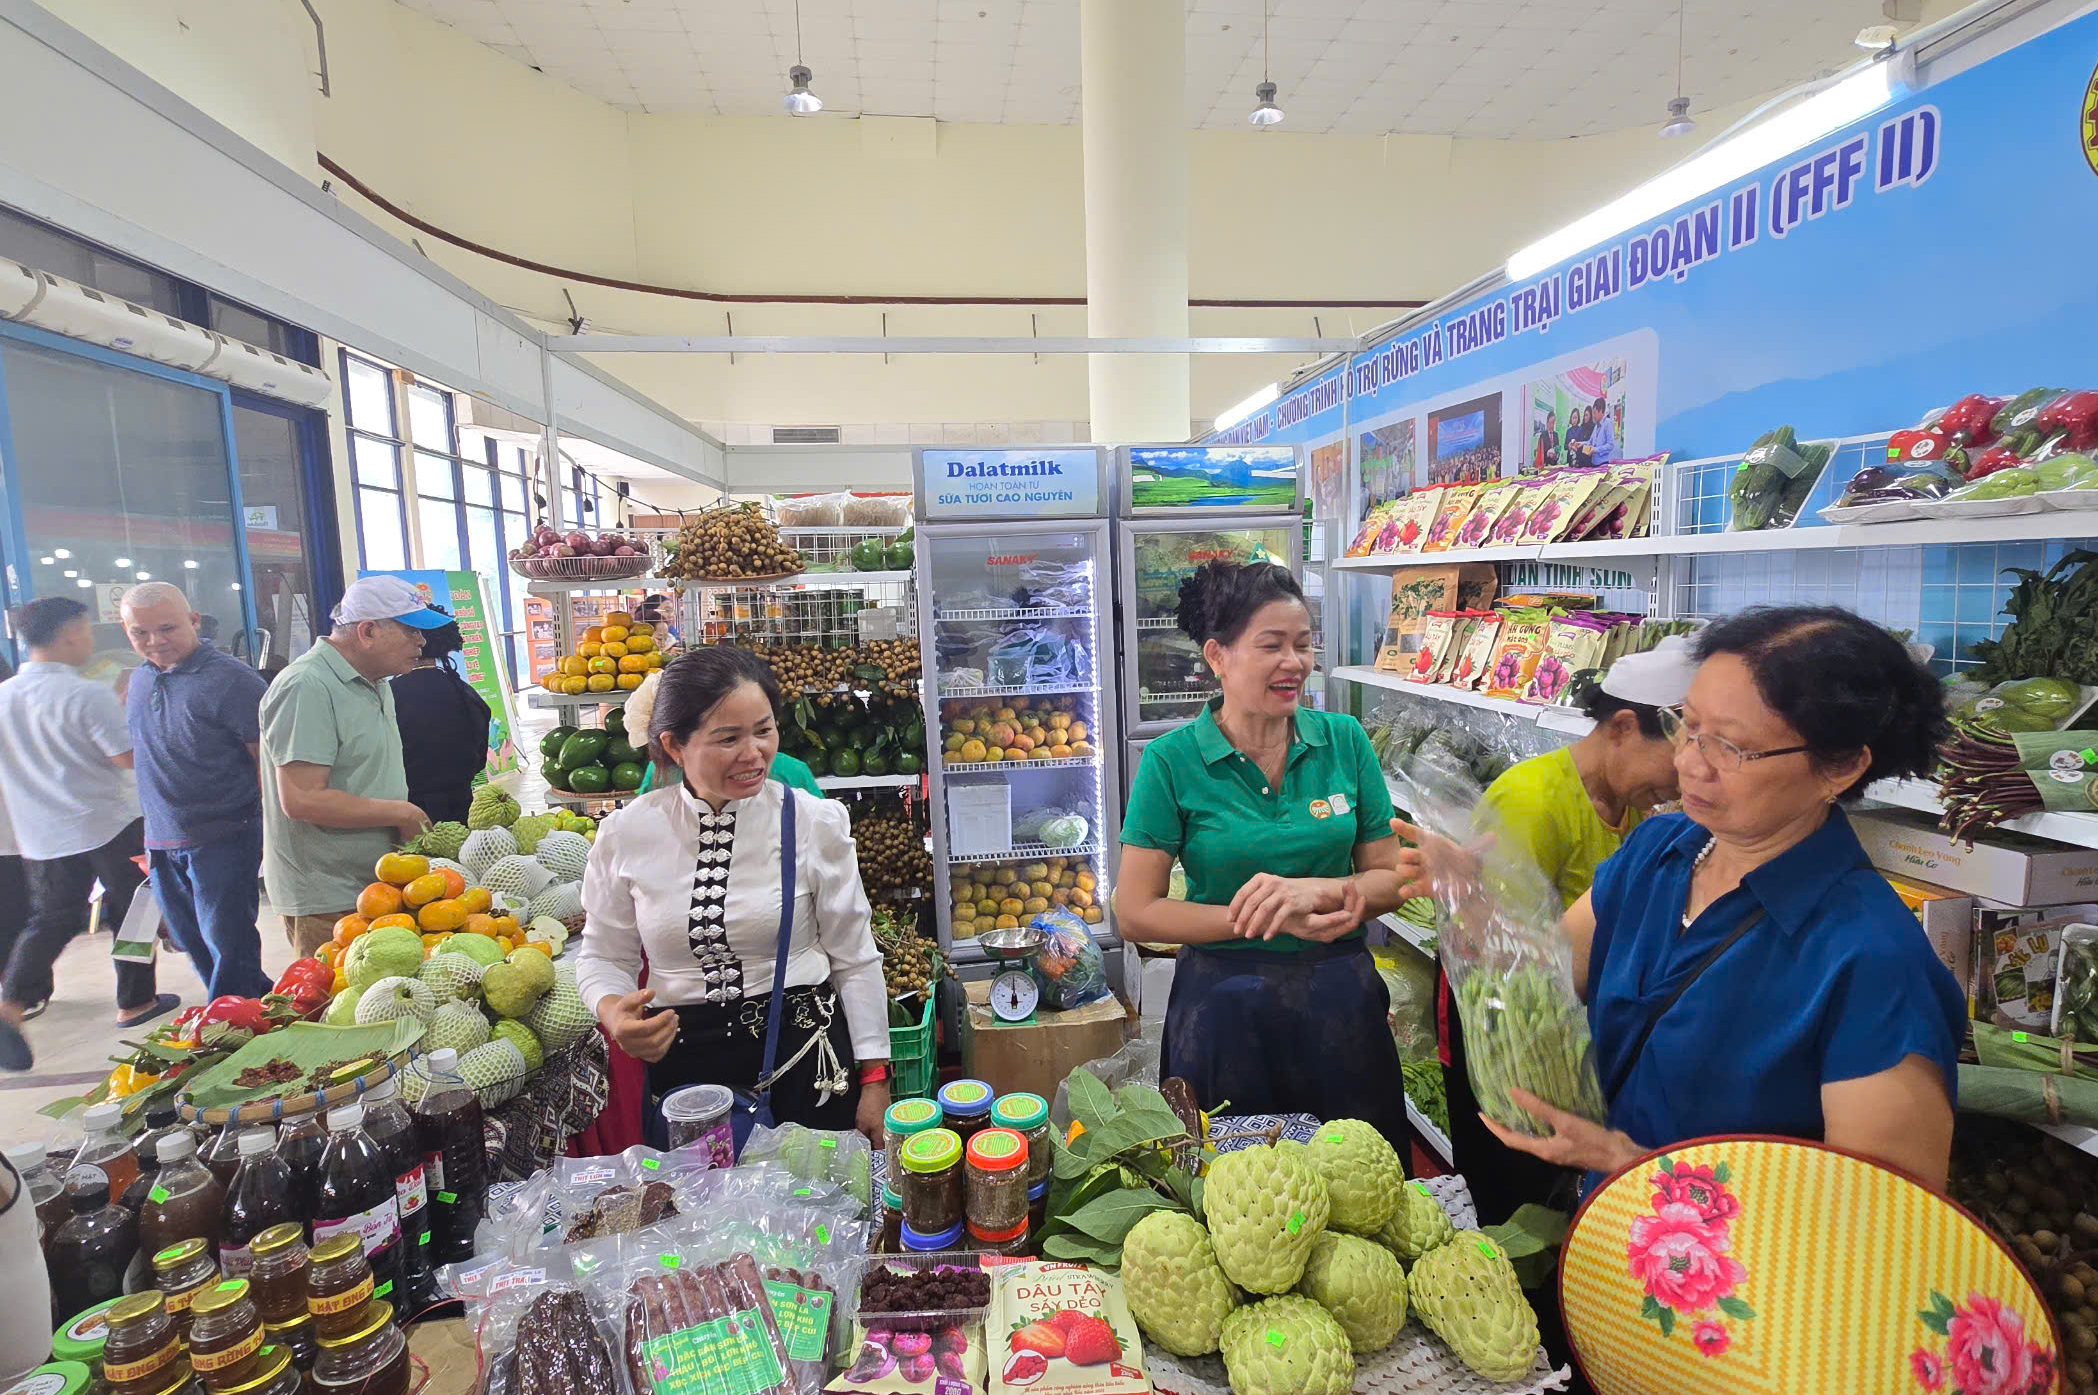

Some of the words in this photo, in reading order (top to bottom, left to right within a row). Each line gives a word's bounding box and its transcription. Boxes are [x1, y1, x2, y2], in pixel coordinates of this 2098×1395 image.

[1253, 413, 1269, 440] NAM
[1277, 390, 1309, 431] CHƯƠNG
[1309, 378, 1337, 415] TRÌNH
[1356, 353, 1379, 398] TRỢ
[1382, 340, 1419, 386] RỪNG
[1422, 323, 1443, 368] VÀ
[1447, 301, 1506, 358] TRANG
[1511, 271, 1562, 331] TRẠI
[1568, 248, 1621, 311] GIAI
[1628, 203, 1721, 280] ĐOẠN
[1730, 186, 1758, 248] II
[1771, 138, 1866, 235] (FFF
[1879, 110, 1936, 189] II)
[946, 460, 1063, 478] Dalatmilk
[938, 492, 962, 505] SỮA
[965, 493, 993, 504] TƯƠI
[996, 493, 1021, 503] CAO
[1024, 489, 1073, 502] NGUYÊN
[986, 551, 1040, 566] SANAKY
[1016, 1283, 1062, 1300] DÂU
[1068, 1280, 1107, 1299] TÂY
[1030, 1298, 1062, 1312] SẤY
[1067, 1296, 1101, 1309] DẺO
